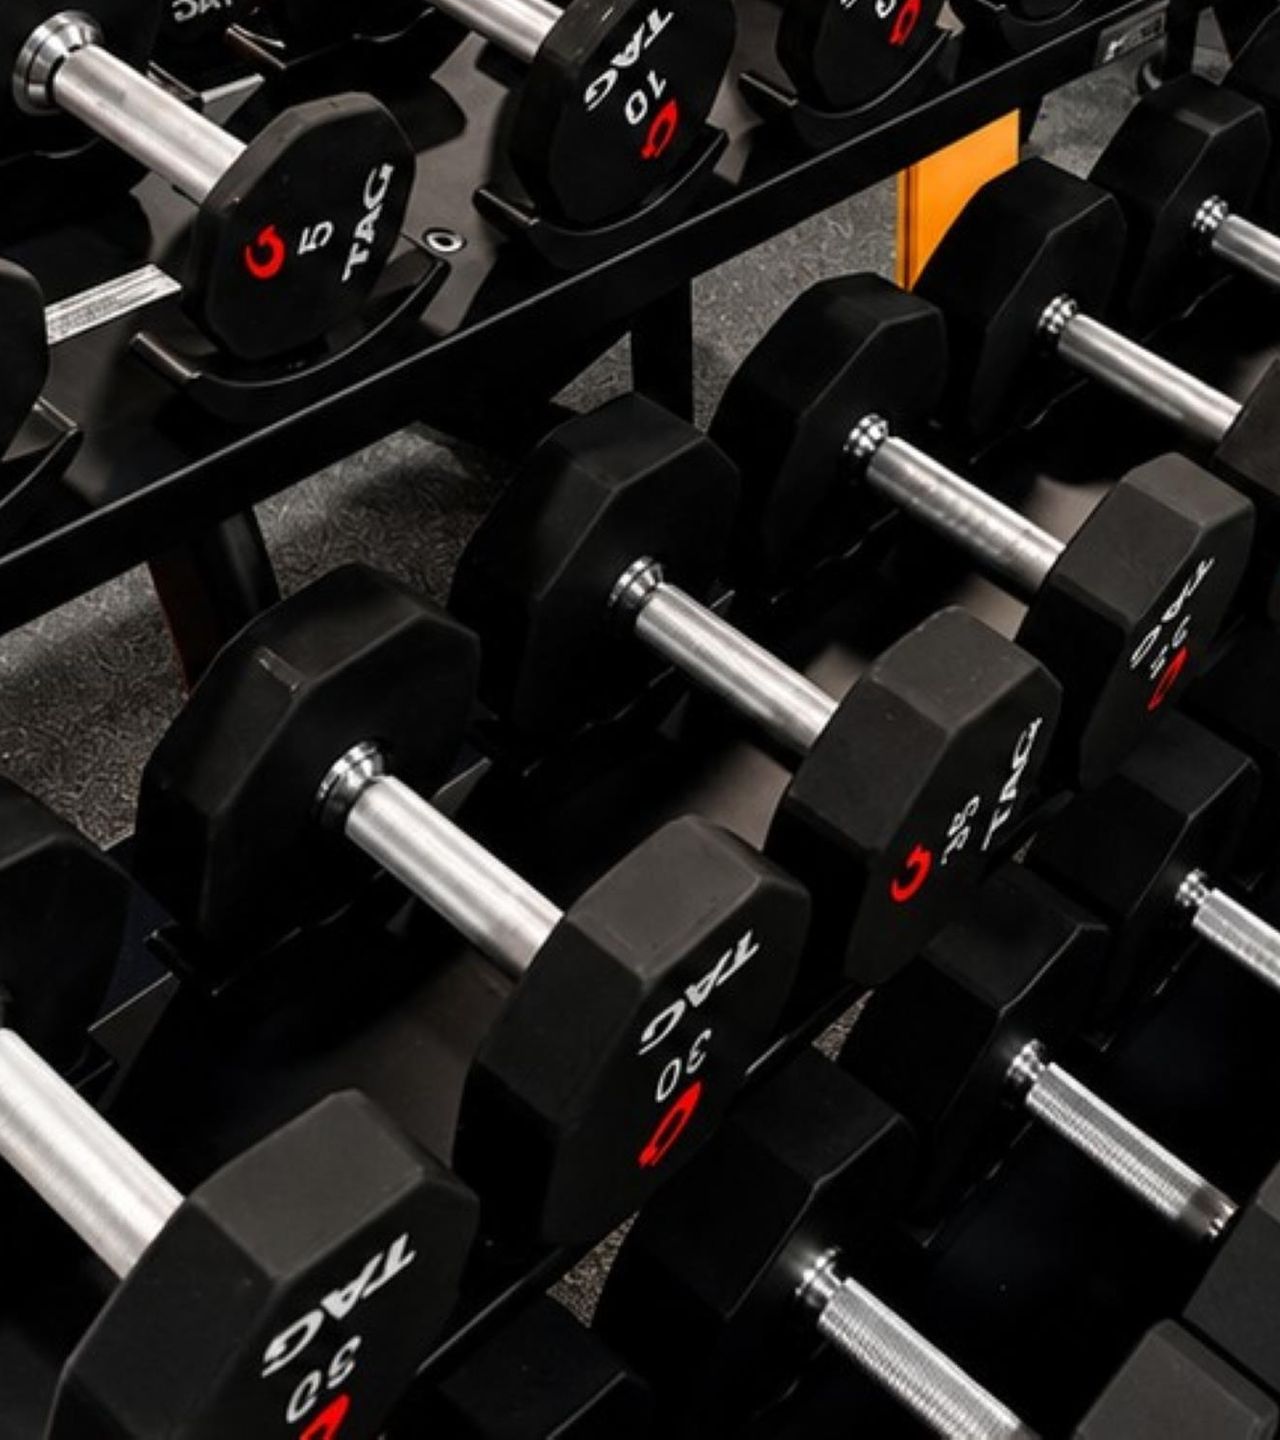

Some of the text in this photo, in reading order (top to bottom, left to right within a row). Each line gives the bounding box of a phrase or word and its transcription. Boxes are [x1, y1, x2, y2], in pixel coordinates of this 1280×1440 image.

[583, 7, 676, 112] TAG
[624, 68, 668, 126] 10
[296, 220, 337, 257] 5
[340, 162, 396, 283] TAG
[980, 716, 1044, 852] TAG
[637, 928, 761, 1057] TAG
[655, 1027, 713, 1104] 30
[261, 1231, 418, 1379] TAG
